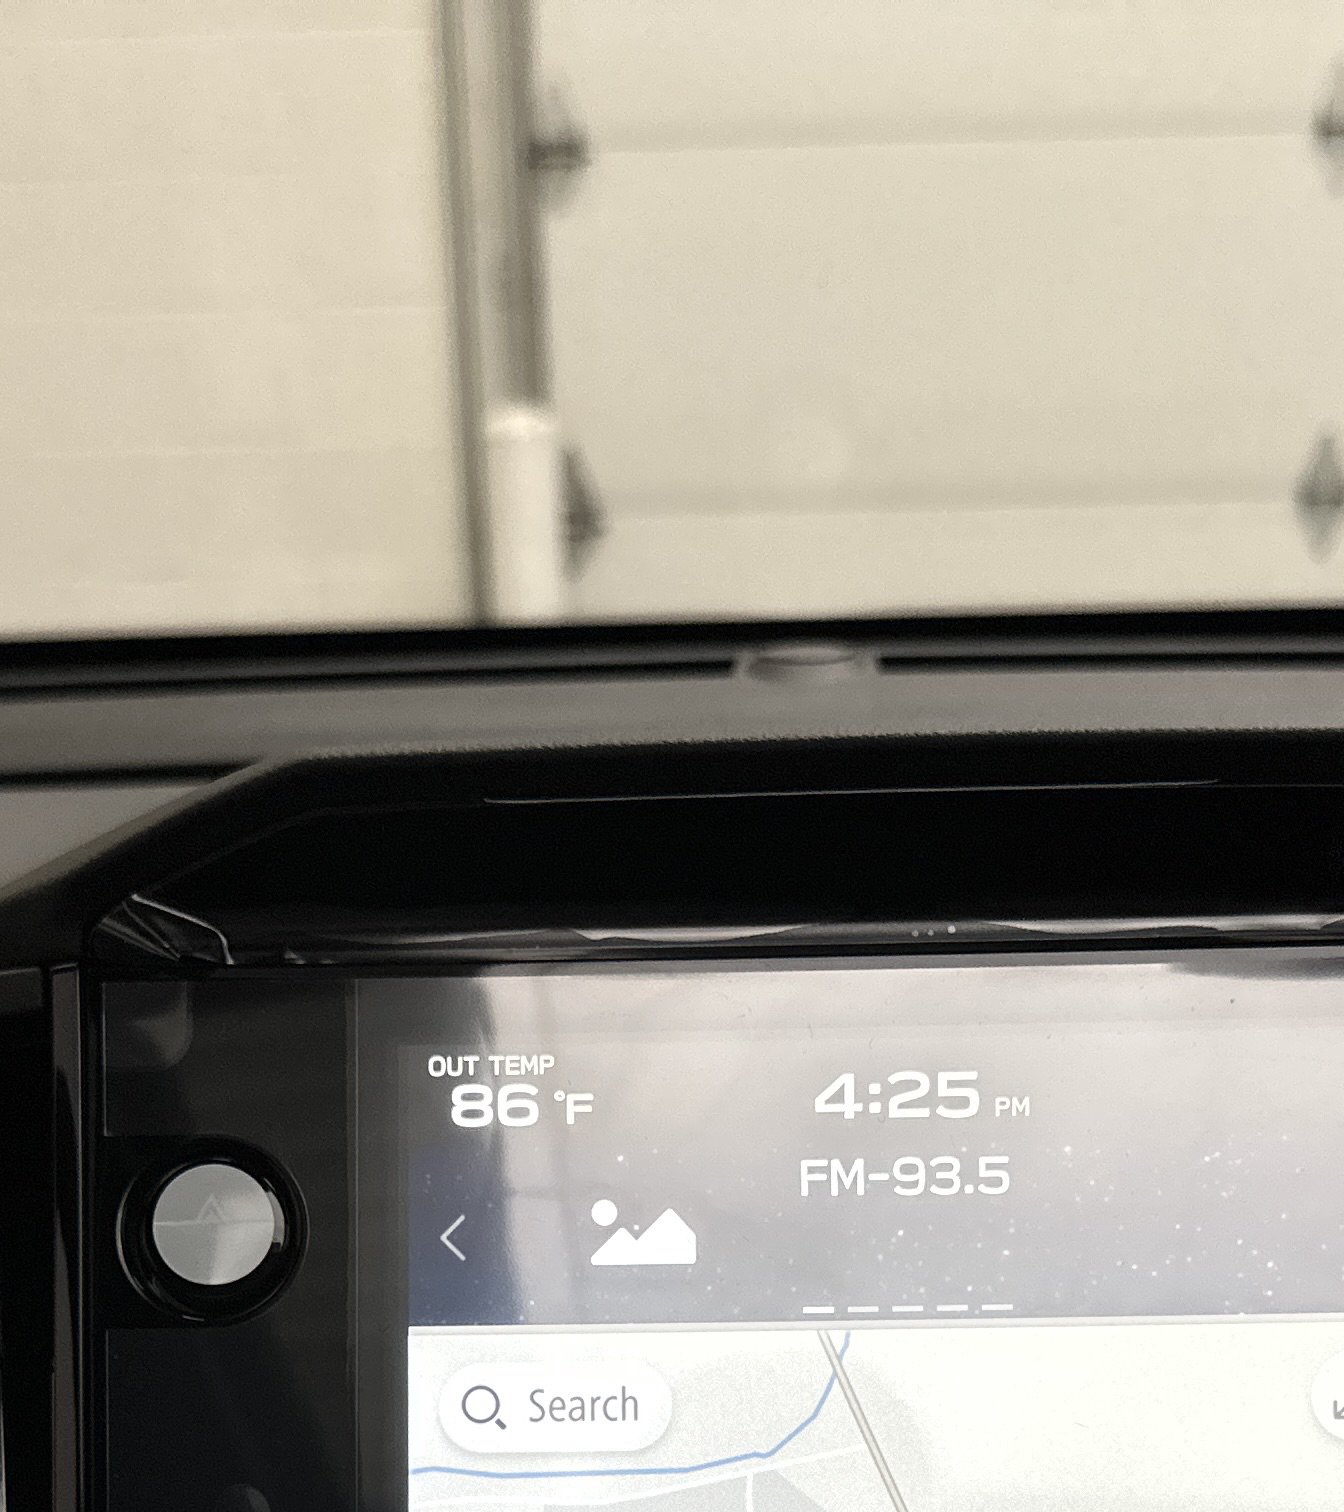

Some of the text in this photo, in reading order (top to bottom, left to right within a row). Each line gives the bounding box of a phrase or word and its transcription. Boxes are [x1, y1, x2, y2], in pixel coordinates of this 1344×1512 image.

[427, 1054, 555, 1077] OUT TEMP
[451, 1083, 540, 1129] 86
[813, 1070, 1031, 1120] 4:25 PM
[799, 1155, 1011, 1198] FM-93.5
[528, 1385, 639, 1423] Search
